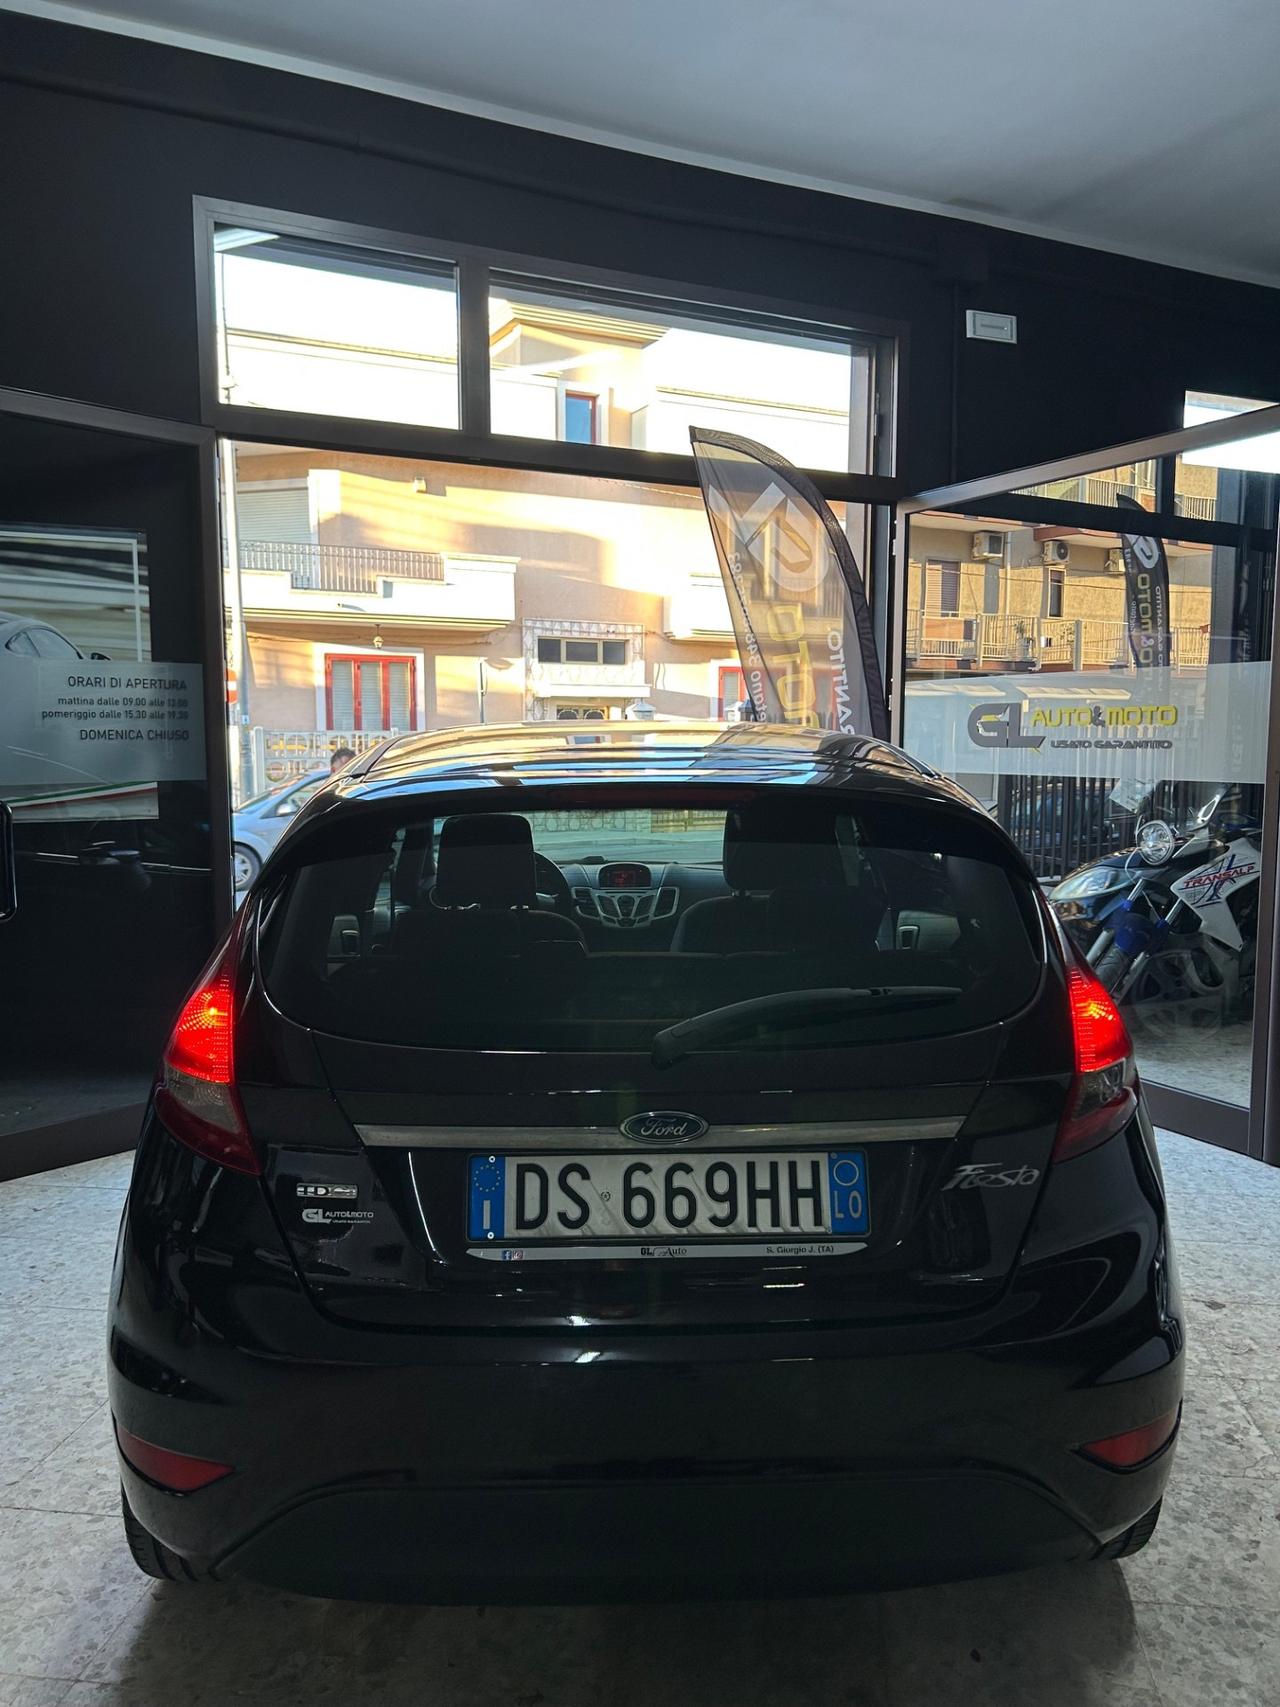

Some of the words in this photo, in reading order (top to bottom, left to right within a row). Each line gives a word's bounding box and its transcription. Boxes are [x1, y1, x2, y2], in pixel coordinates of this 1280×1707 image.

[67, 676, 106, 688] ORARI
[110, 677, 122, 688] DI
[126, 678, 188, 691] APERTURA
[57, 696, 94, 706] mattina
[97, 696, 120, 706] dalle
[122, 697, 147, 707] 09.00
[149, 698, 166, 707] alle
[42, 709, 97, 720] pomeriggio
[99, 709, 122, 719] dalle
[149, 710, 166, 720] alle
[967, 702, 1047, 749] GL
[79, 729, 144, 741] DOMENICA
[147, 729, 190, 741] CHIUSO
[1050, 739, 1092, 750] USATO
[1093, 739, 1173, 750] GARANTITO
[1183, 864, 1255, 889] TRANSALP
[639, 1116, 689, 1138] Ford
[941, 1162, 1040, 1191] Fiesta
[515, 1162, 591, 1231] DS
[622, 1160, 823, 1229] 669HH
[833, 1189, 863, 1220] LO
[302, 1208, 332, 1224] GL
[776, 1246, 807, 1255] Giorgio
[817, 1244, 834, 1254] (TA)
